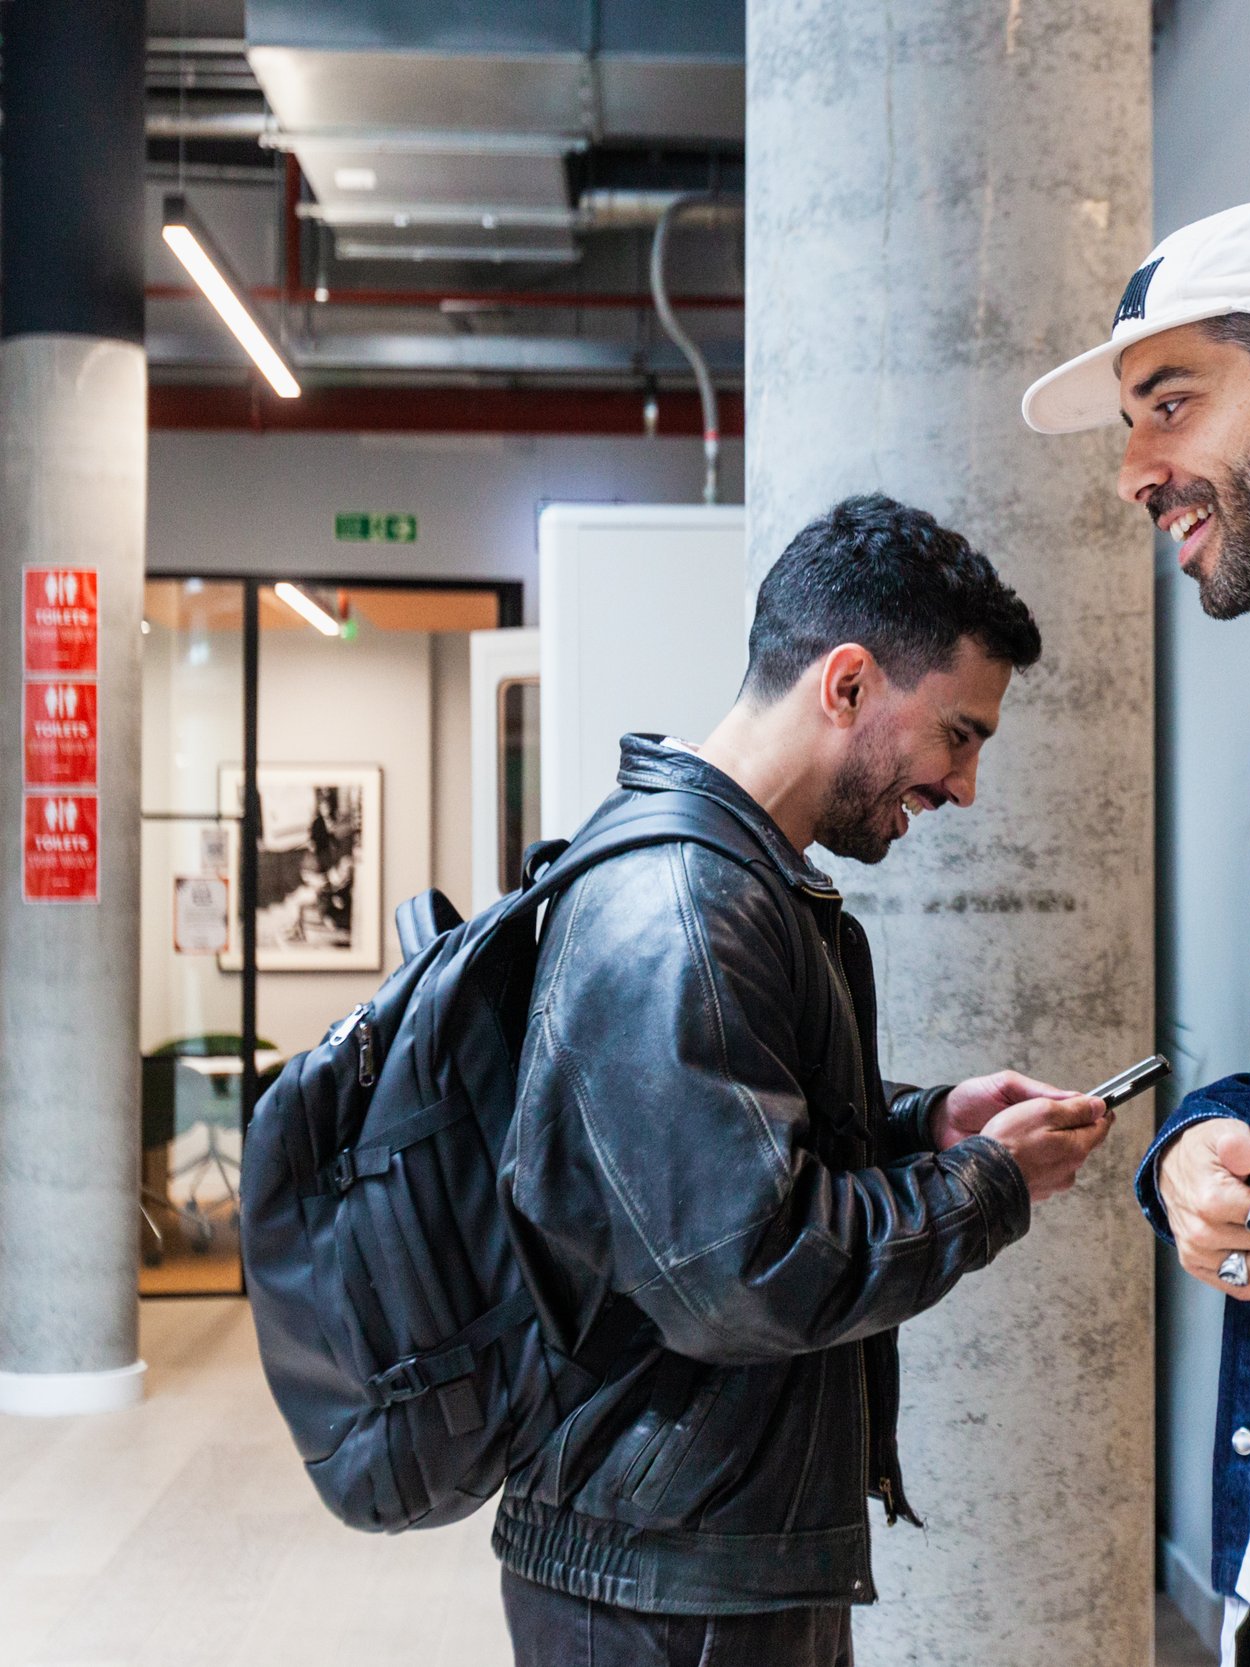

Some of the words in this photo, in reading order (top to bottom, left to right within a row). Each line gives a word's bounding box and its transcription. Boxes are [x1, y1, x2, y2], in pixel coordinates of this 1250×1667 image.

[36, 608, 89, 626] TOILETS
[35, 721, 89, 738] TOILETS
[34, 834, 89, 852] TOILETS
